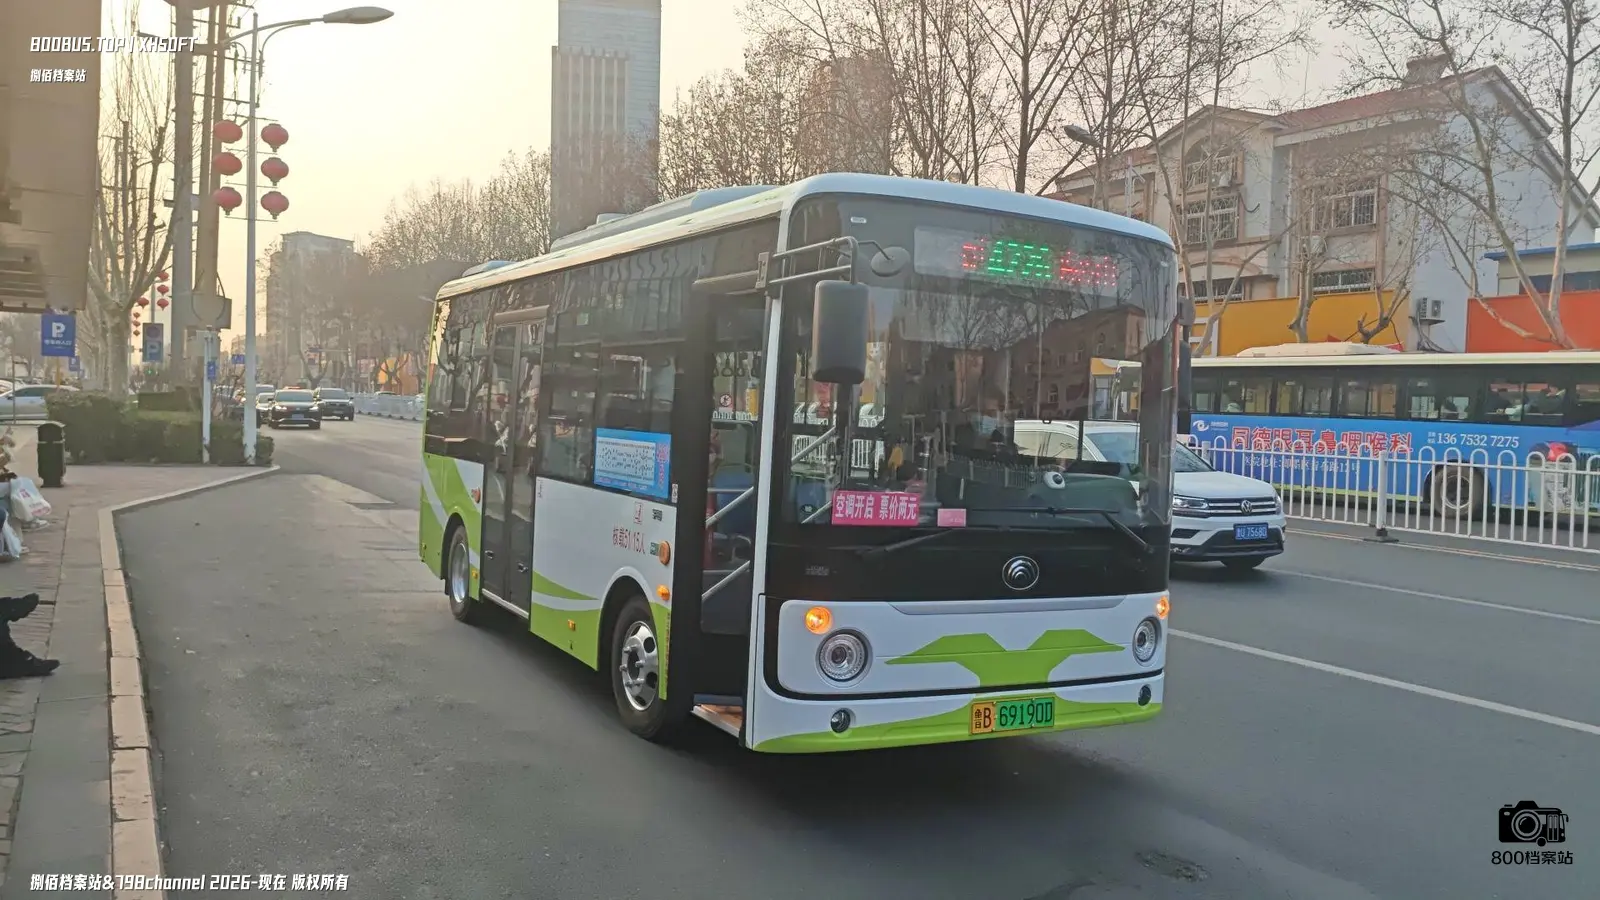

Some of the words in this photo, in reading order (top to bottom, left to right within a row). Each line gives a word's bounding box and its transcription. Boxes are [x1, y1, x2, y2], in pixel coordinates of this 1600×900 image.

[51, 322, 66, 338] P
[1437, 432, 1457, 445] 136
[1460, 433, 1488, 447] 7532
[1491, 435, 1520, 449] 7275
[835, 494, 875, 519] 空调开启
[879, 495, 918, 520] 票价两元
[973, 707, 992, 729] 鲁B
[999, 701, 1054, 727] 69190D
